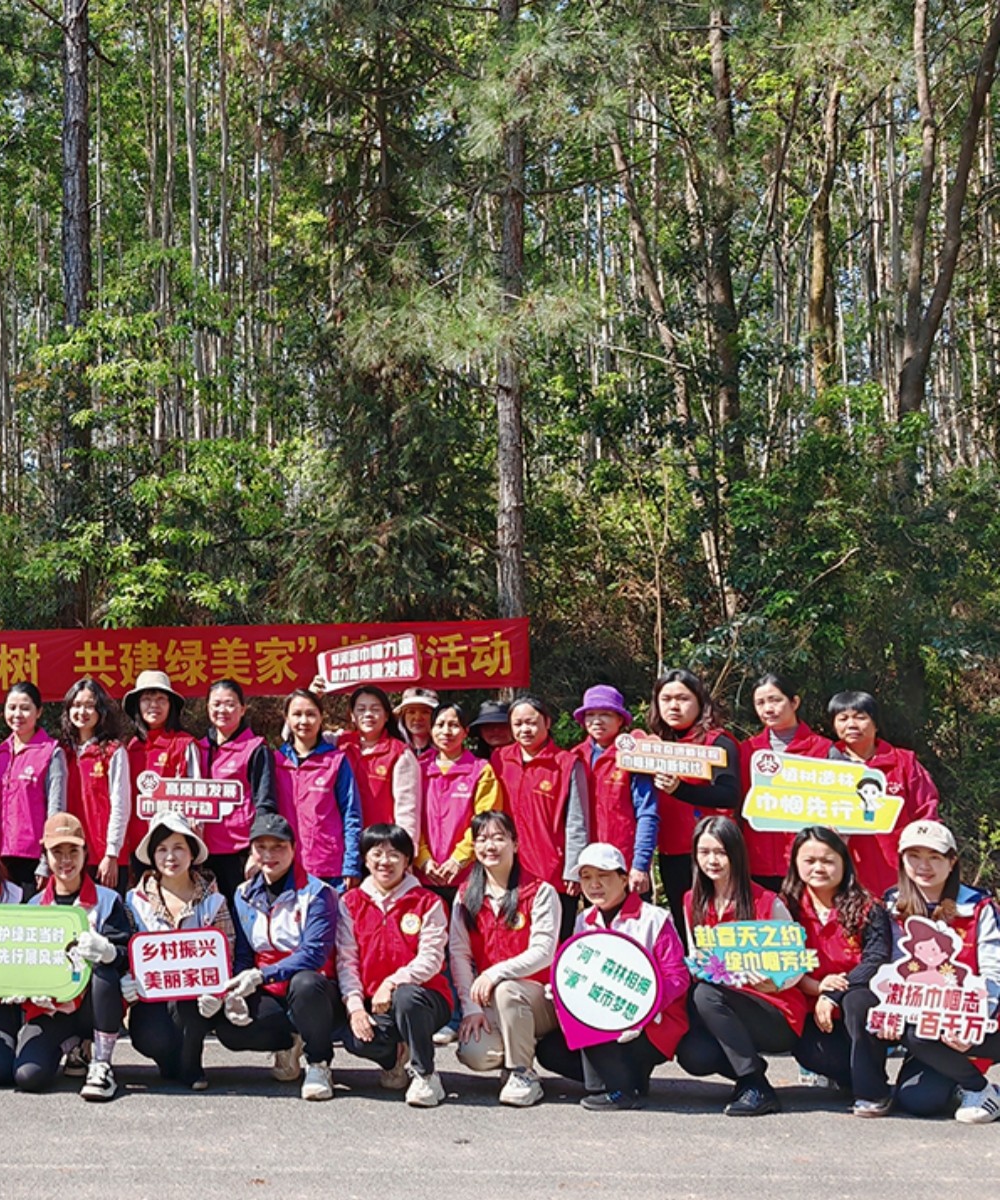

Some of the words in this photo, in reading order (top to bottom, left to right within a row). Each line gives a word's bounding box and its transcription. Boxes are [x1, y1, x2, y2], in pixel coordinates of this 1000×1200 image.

[331, 659, 414, 682] 助力高质量发展
[782, 767, 854, 786] 植树造林
[165, 781, 237, 798] 高质量发展
[756, 792, 855, 820] 巾帼先行
[694, 925, 801, 947] 赴春天之约
[142, 939, 217, 962] 乡村振兴
[724, 949, 819, 972] 绽巾帼芳华
[144, 967, 219, 990] 美丽家园
[886, 983, 980, 1012] 激扬巾帼志
